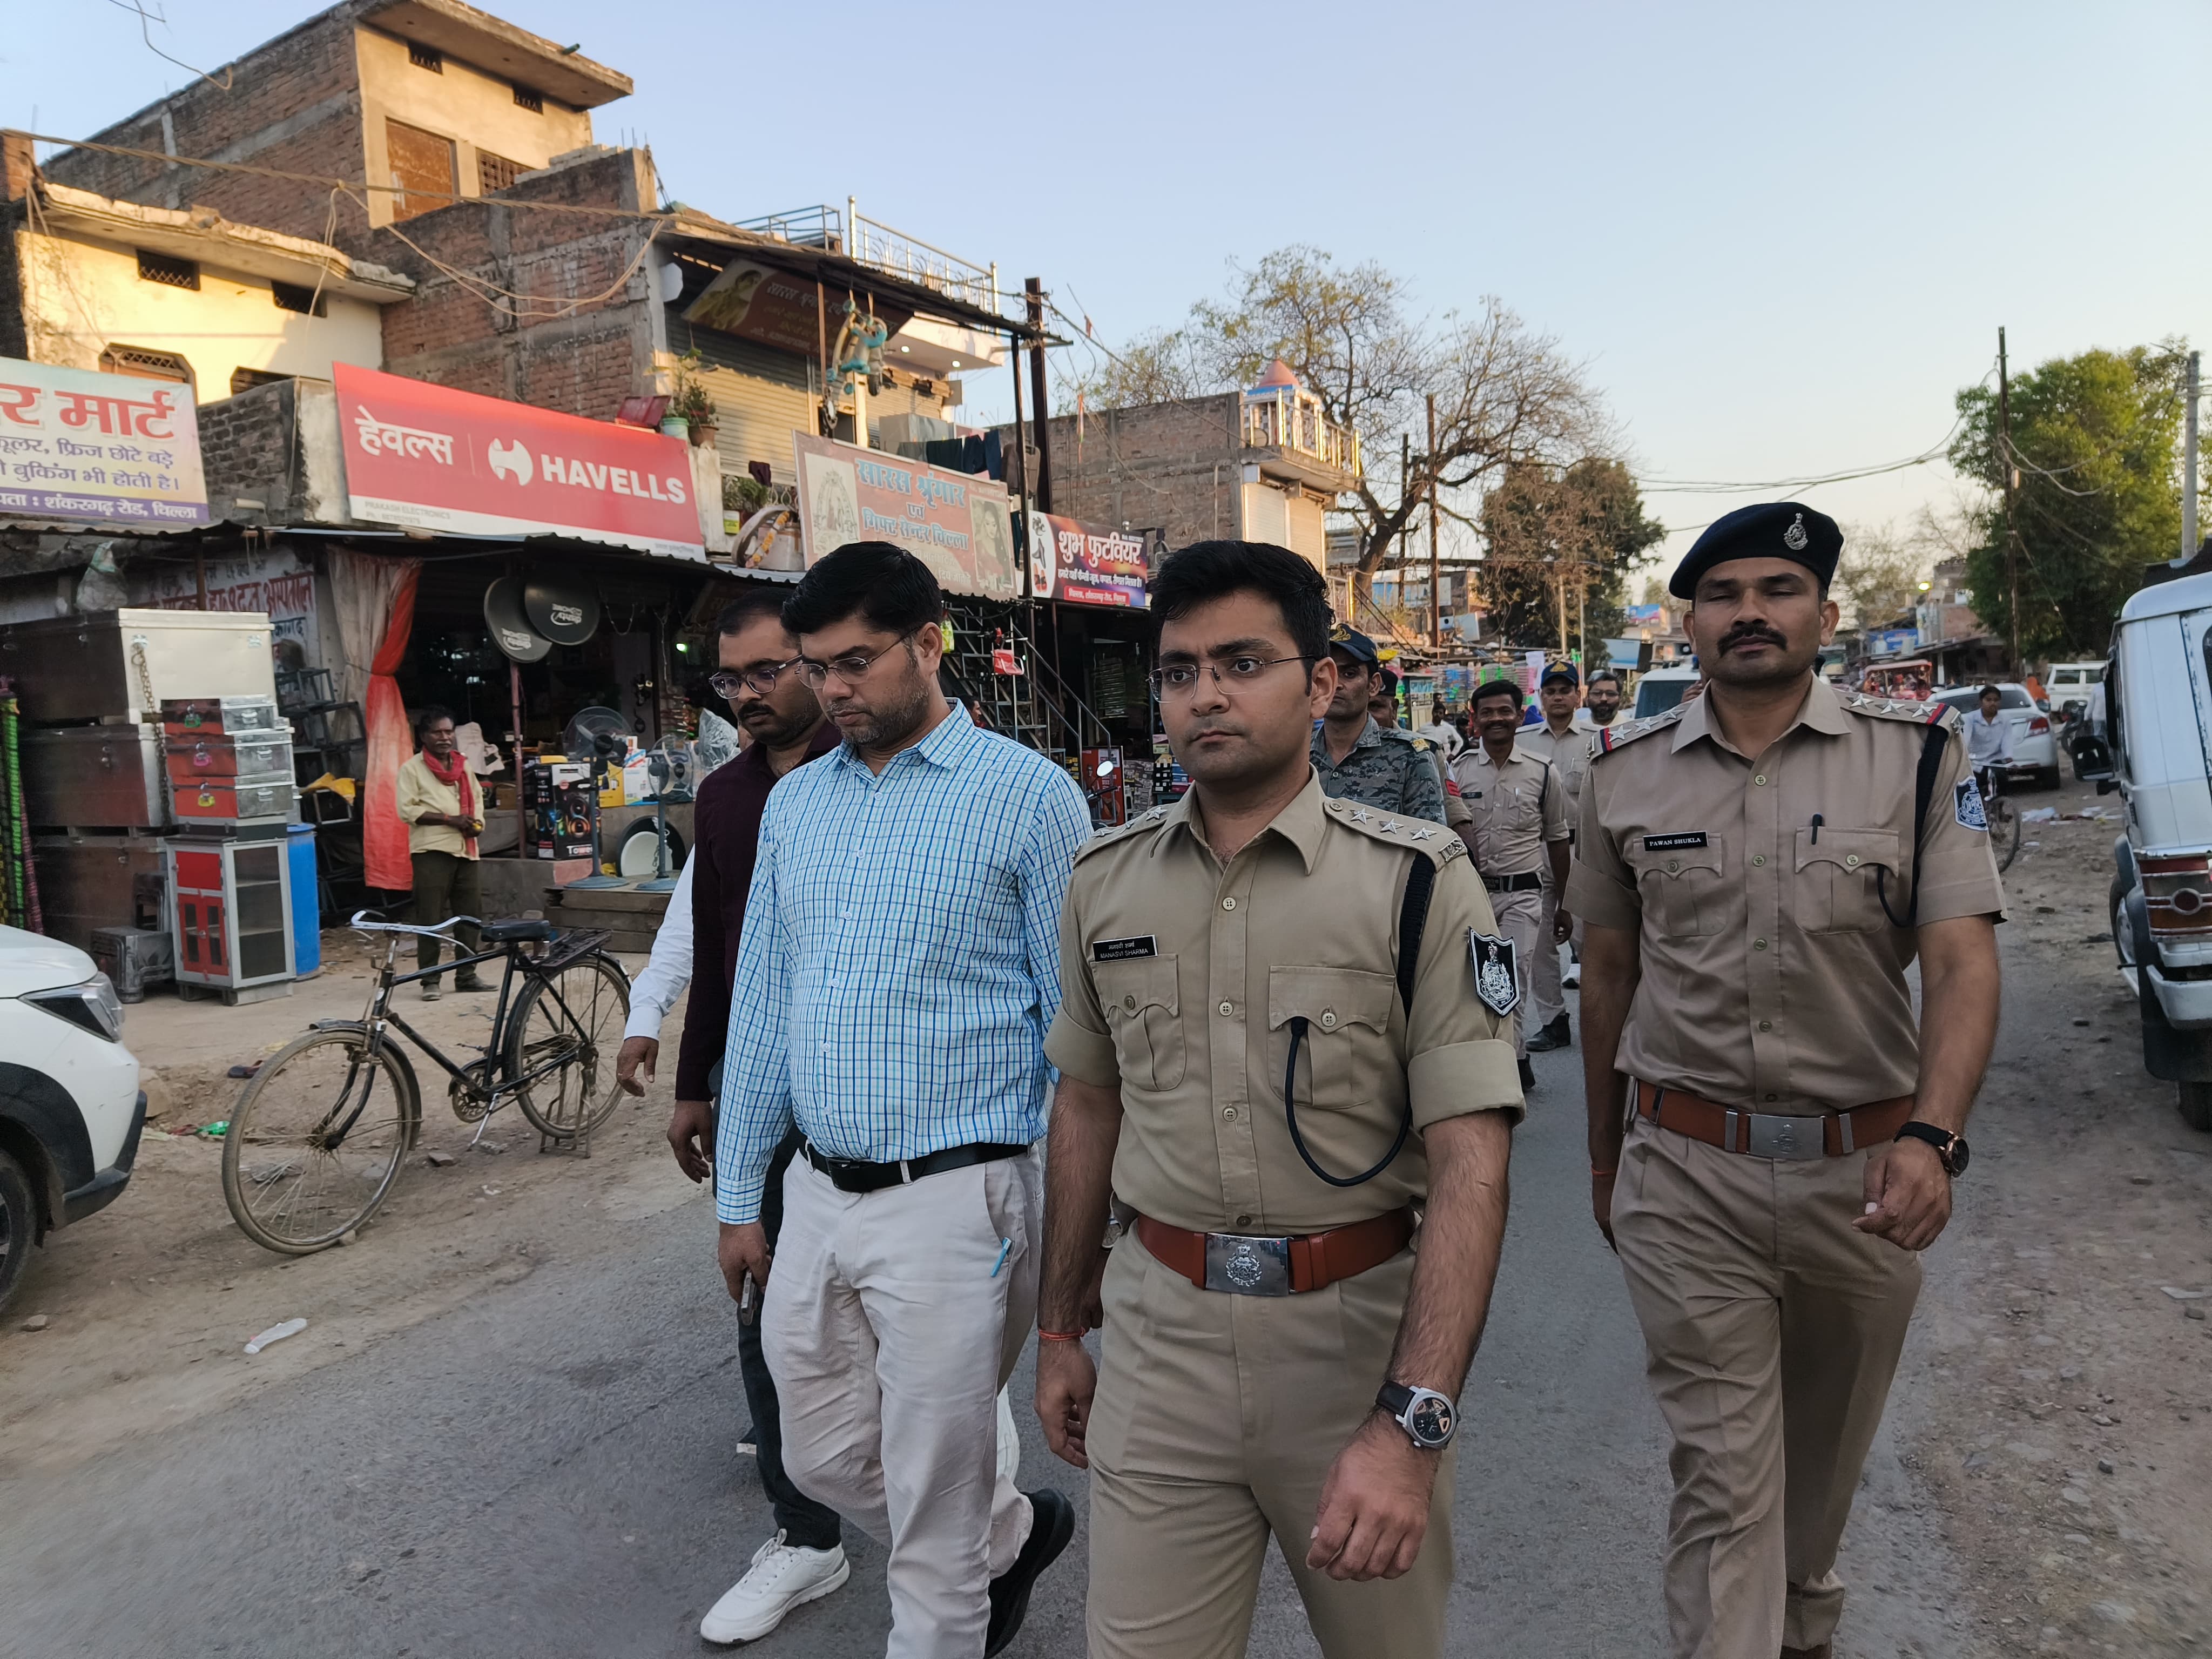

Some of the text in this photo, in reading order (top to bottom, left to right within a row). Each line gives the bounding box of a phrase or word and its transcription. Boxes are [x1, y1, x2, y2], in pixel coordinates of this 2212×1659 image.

[55, 390, 175, 439] मार्ट
[354, 405, 454, 464] हेवल्स
[57, 438, 103, 458] फ्रिज
[108, 444, 142, 462] छोटे
[12, 461, 77, 482] बुकिंग
[83, 467, 105, 484] भी
[111, 469, 151, 488] होती
[541, 454, 686, 504] HAVELLS
[854, 457, 912, 495] सारस
[861, 507, 898, 536] गिफ्ट
[907, 502, 925, 520] एवं
[1058, 530, 1143, 568] शुभ फुटवियर
[1438, 838, 1465, 863] IPS
[1125, 948, 1149, 956] SHARMA
